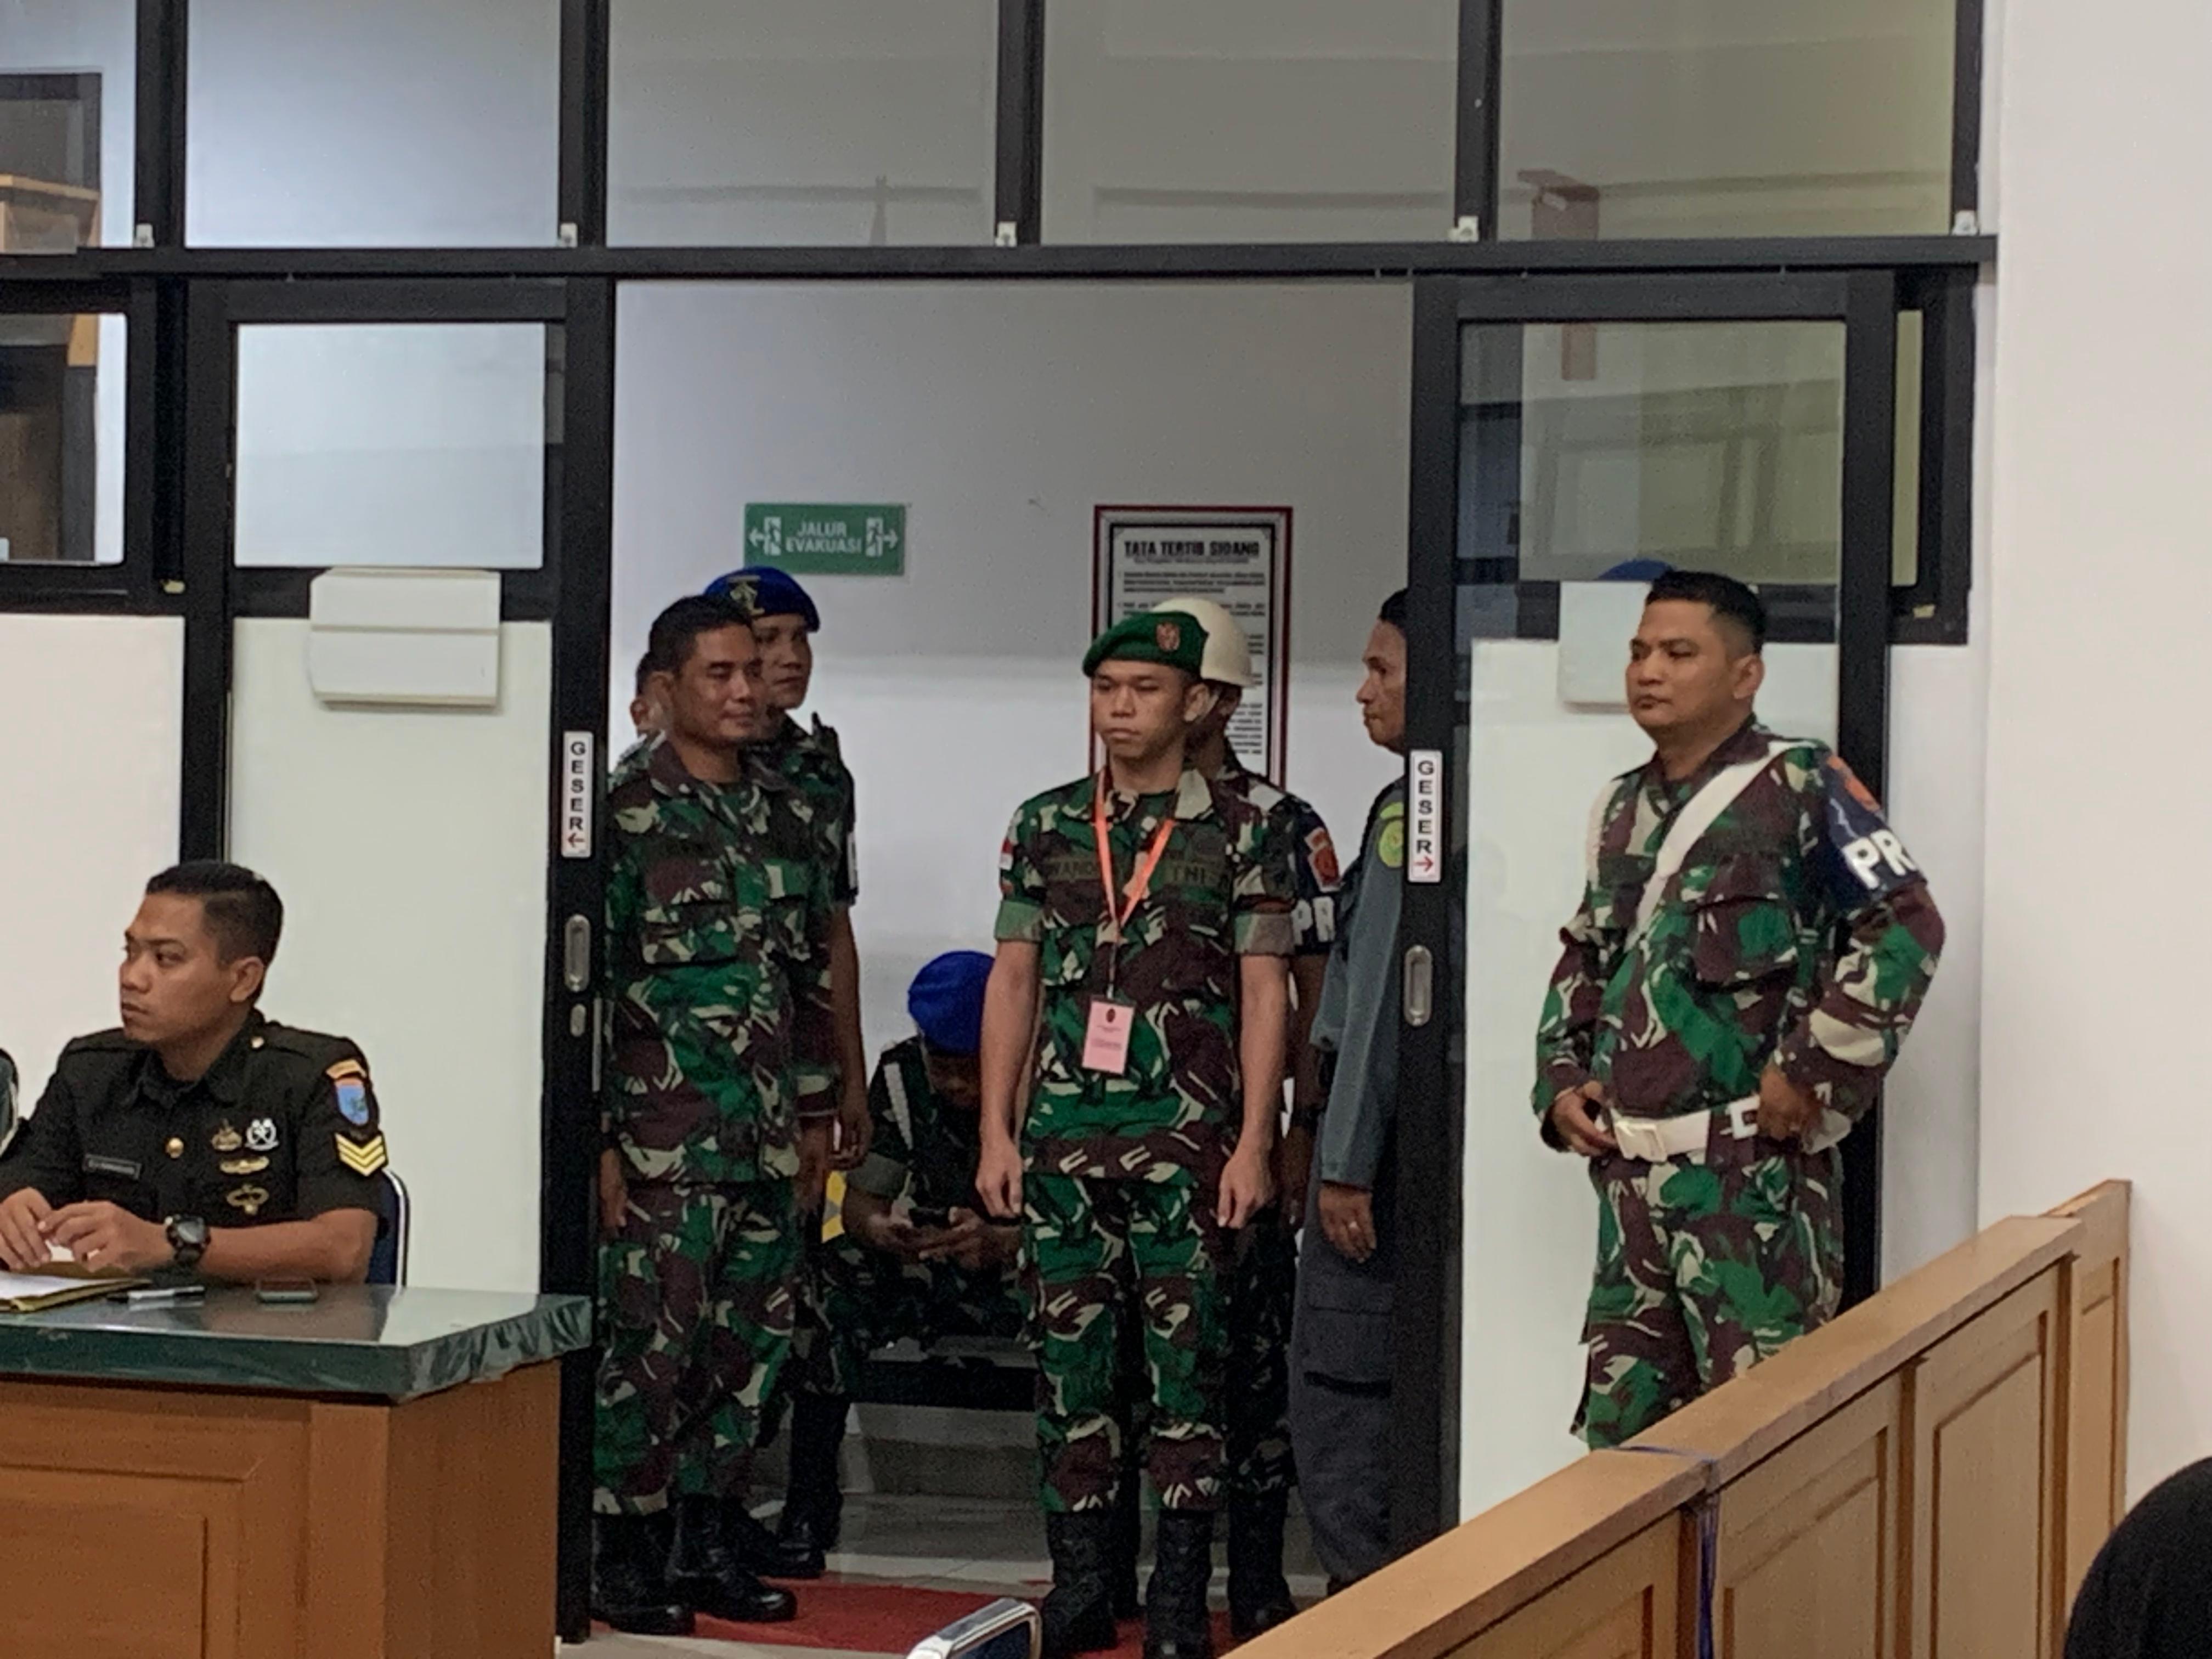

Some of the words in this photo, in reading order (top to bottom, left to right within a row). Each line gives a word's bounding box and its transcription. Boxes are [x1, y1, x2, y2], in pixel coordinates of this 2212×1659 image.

[797, 521, 847, 537] JALUR
[786, 537, 862, 554] EVAKUASI
[1125, 541, 1156, 556] TATA
[1160, 541, 1205, 556] TERTIB
[1210, 541, 1260, 557] SIDANG
[569, 741, 586, 831] GESER
[1417, 760, 1435, 854] GESER
